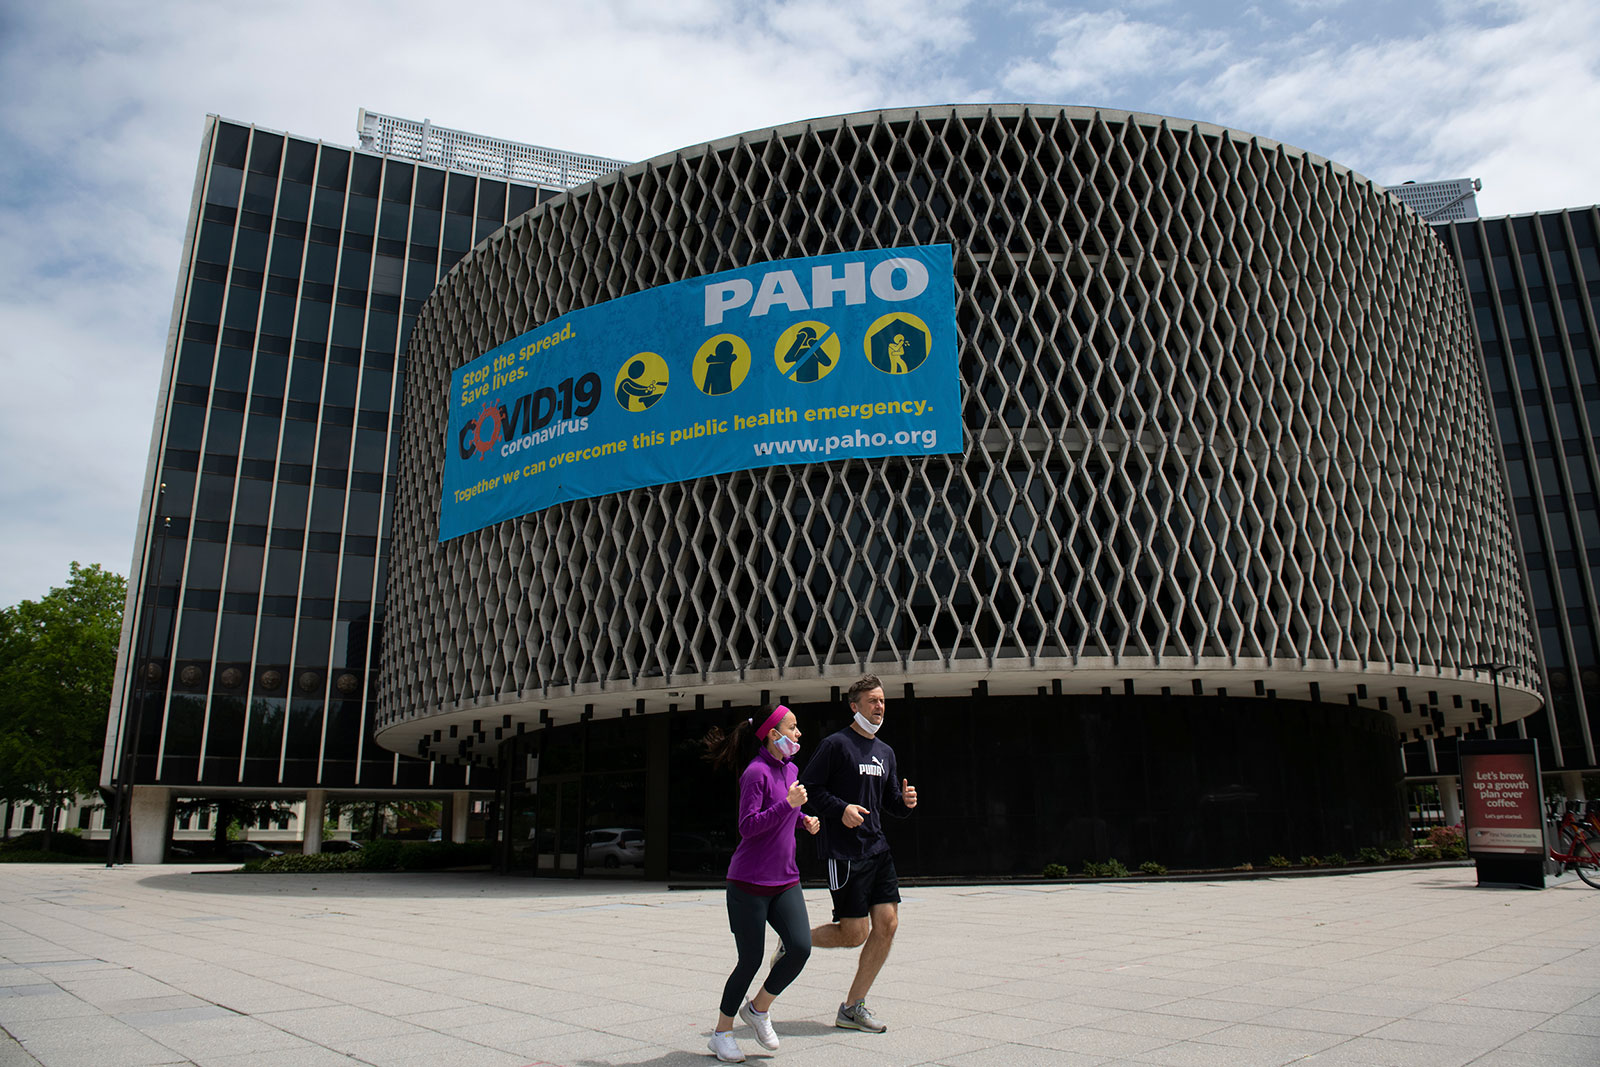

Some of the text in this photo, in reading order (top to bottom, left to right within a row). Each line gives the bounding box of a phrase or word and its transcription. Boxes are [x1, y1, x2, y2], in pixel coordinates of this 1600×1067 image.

[704, 257, 929, 327] PAHO
[462, 322, 577, 390] Stop the spread.
[461, 366, 529, 407] Save lives.
[501, 417, 589, 457] coronavirus
[753, 429, 937, 457] www.paho.org
[454, 400, 934, 504] Together we can overcome this public health emergency.
[859, 764, 882, 777] PUMA
[1476, 771, 1524, 780] Let's brew
[1473, 782, 1486, 790] up
[1495, 781, 1529, 791] growth
[1480, 790, 1523, 799] plan over
[1487, 799, 1518, 808] coffee.
